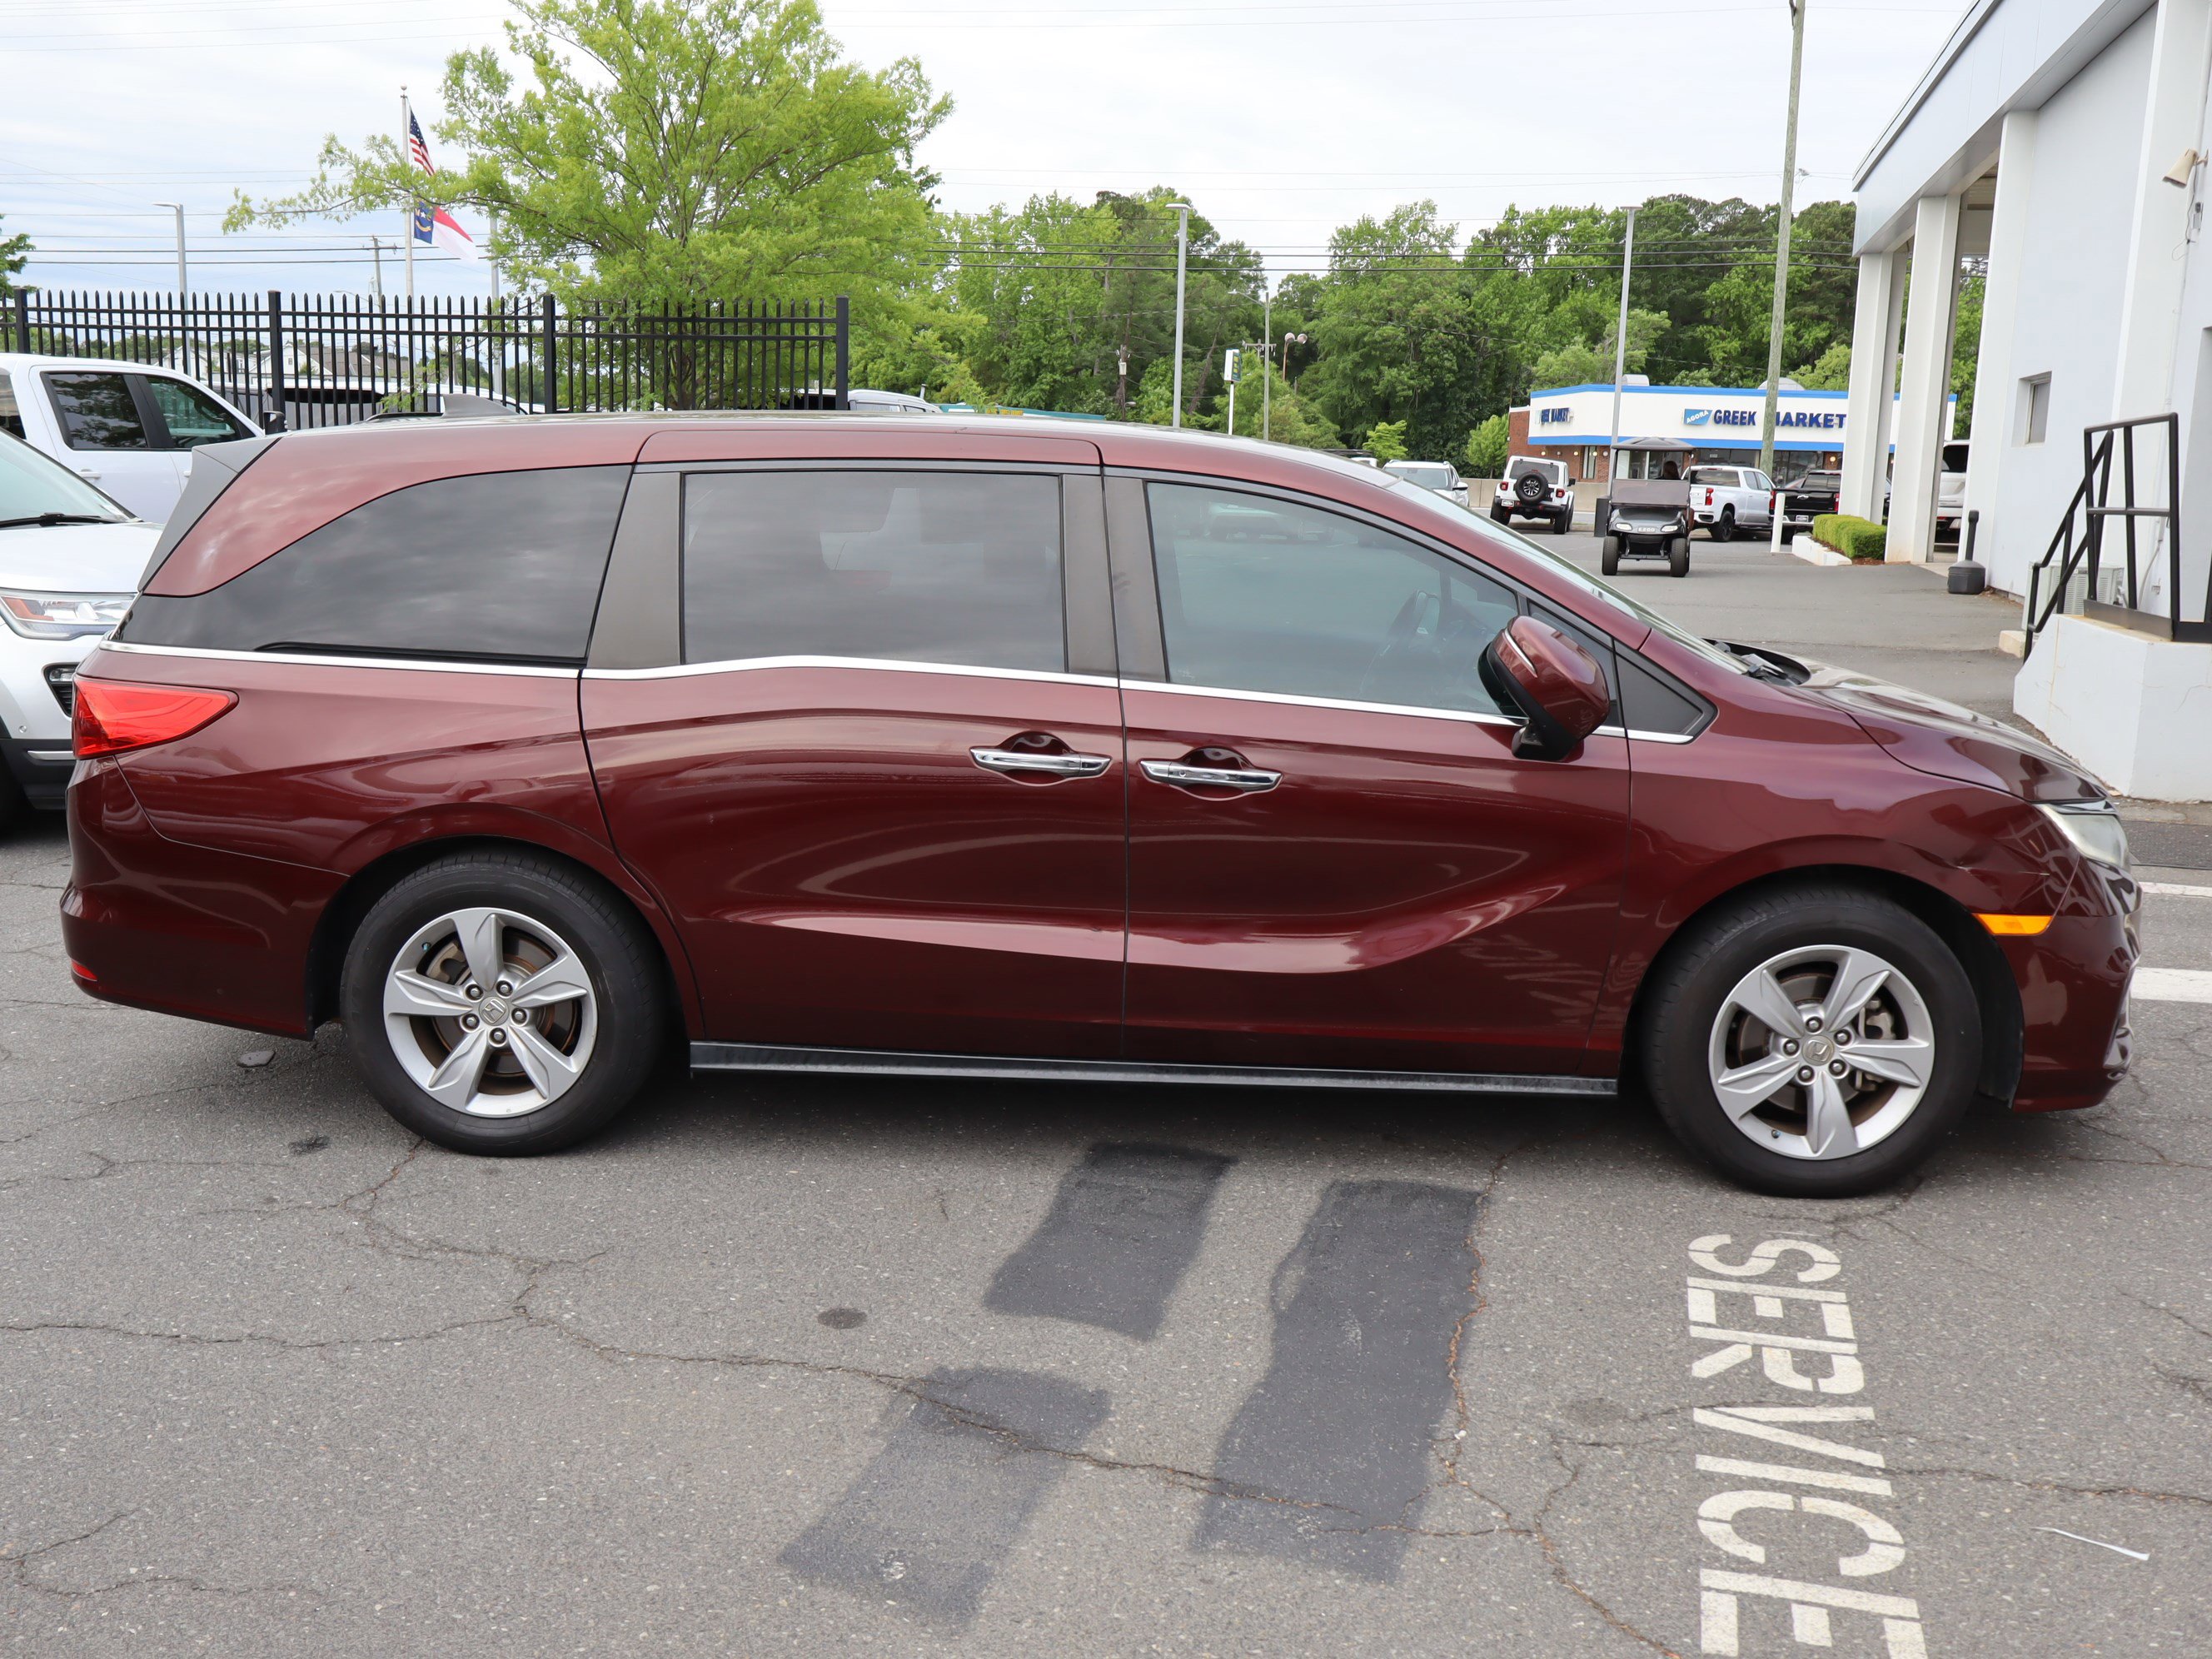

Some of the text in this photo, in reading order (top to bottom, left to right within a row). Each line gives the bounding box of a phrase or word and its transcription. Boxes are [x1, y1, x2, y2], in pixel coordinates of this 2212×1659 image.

[1686, 410, 1709, 424] AGORA
[1713, 409, 1757, 426] GREEK
[1686, 1233, 1929, 1659] SERVICE
